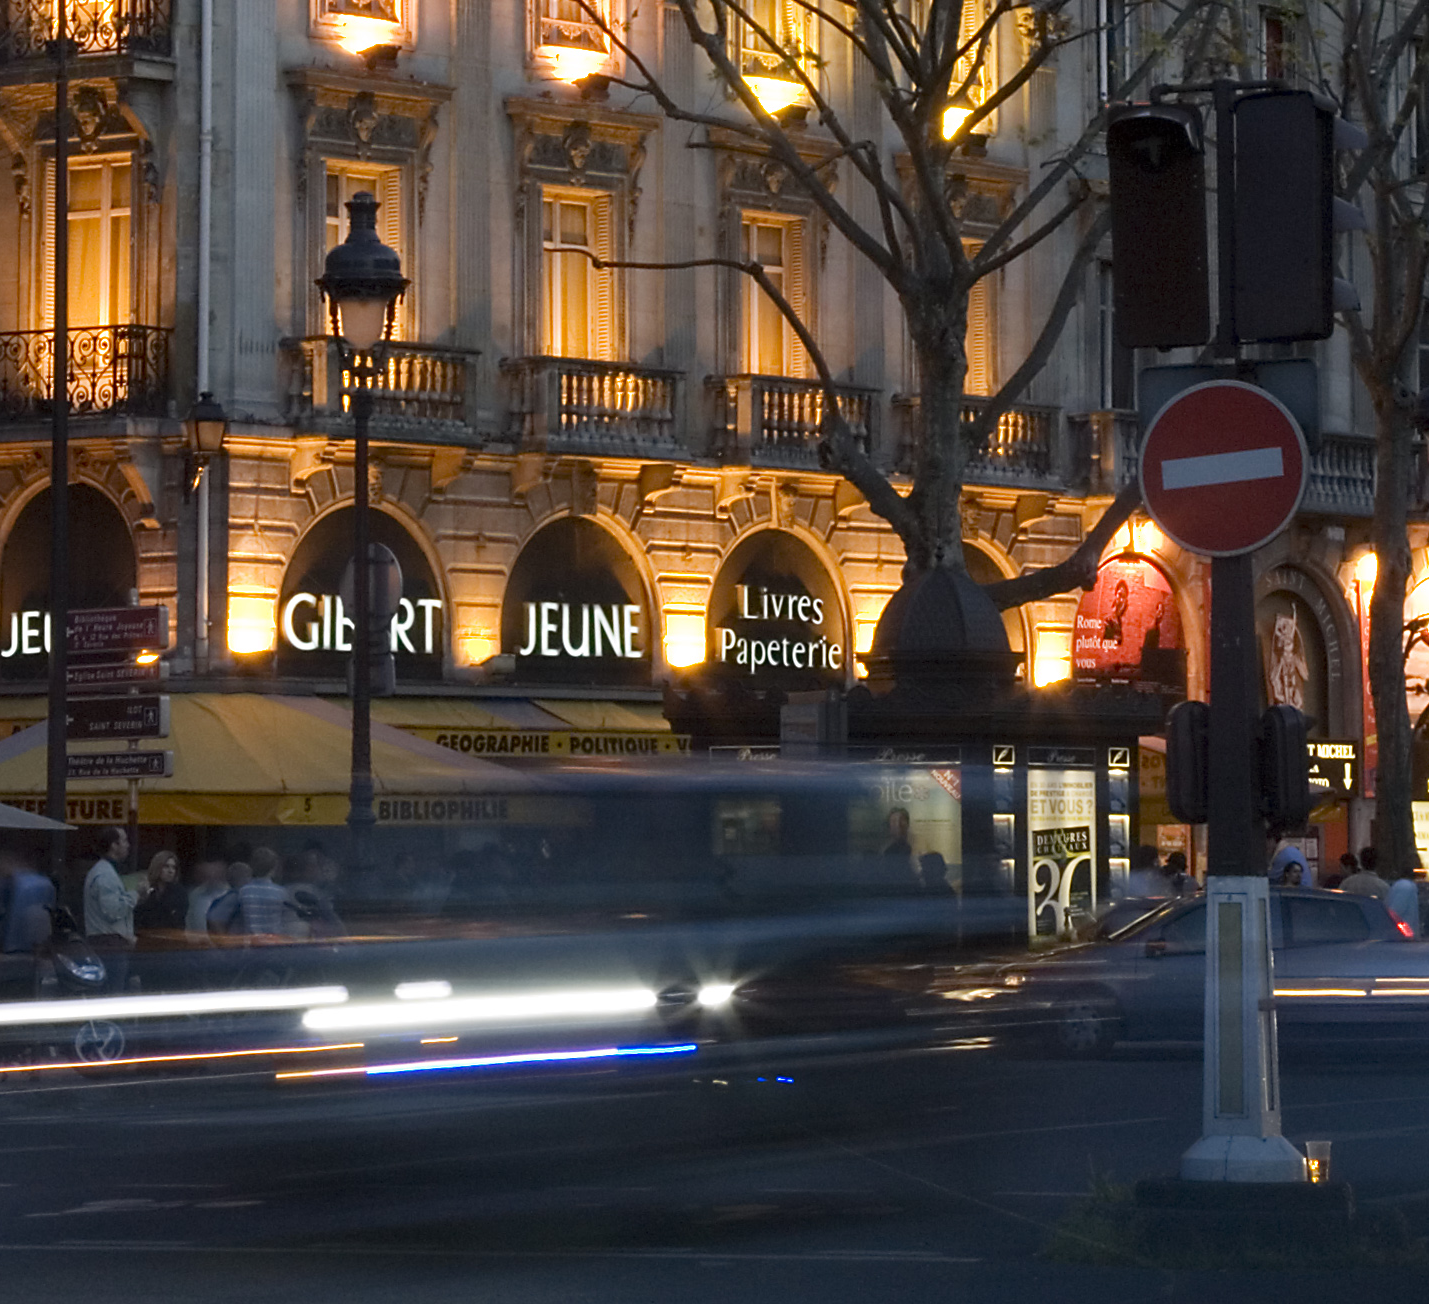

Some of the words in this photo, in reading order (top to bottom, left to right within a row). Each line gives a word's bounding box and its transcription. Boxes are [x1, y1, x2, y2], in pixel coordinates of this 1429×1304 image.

[742, 584, 824, 625] Livres
[93, 623, 113, 632] Heure
[284, 592, 443, 654] GIBRT
[520, 601, 644, 659] JEUNE
[1077, 614, 1102, 630] Rome
[1265, 569, 1307, 591] SAINT
[1315, 596, 1342, 682] MICHEL
[721, 628, 842, 675] Papeterie
[1075, 634, 1101, 653] plutôt
[1102, 638, 1119, 653] que
[1075, 658, 1097, 669] vous
[96, 670, 114, 679] Saint
[116, 668, 145, 677] SEVERIN
[127, 705, 144, 714] ILOT
[89, 722, 110, 731] SAINT
[113, 721, 144, 730] SEVERIN
[436, 733, 551, 754] GEOGRAPHIE
[570, 736, 659, 755] POLITIQUE
[1317, 743, 1357, 760] MICHEL
[95, 757, 104, 765] de
[106, 756, 113, 764] la
[115, 755, 147, 764] Huchette
[736, 747, 778, 762] Presse
[876, 747, 927, 762] Presse
[931, 769, 961, 800] NOUVEAU
[1030, 789, 1038, 797] DE
[1039, 789, 1065, 797] PRESTIGE
[378, 798, 509, 821] BIBLIOPHILIE
[1030, 799, 1046, 815] ET
[1048, 799, 1084, 815] VOUS
[1087, 799, 1093, 815] ?
